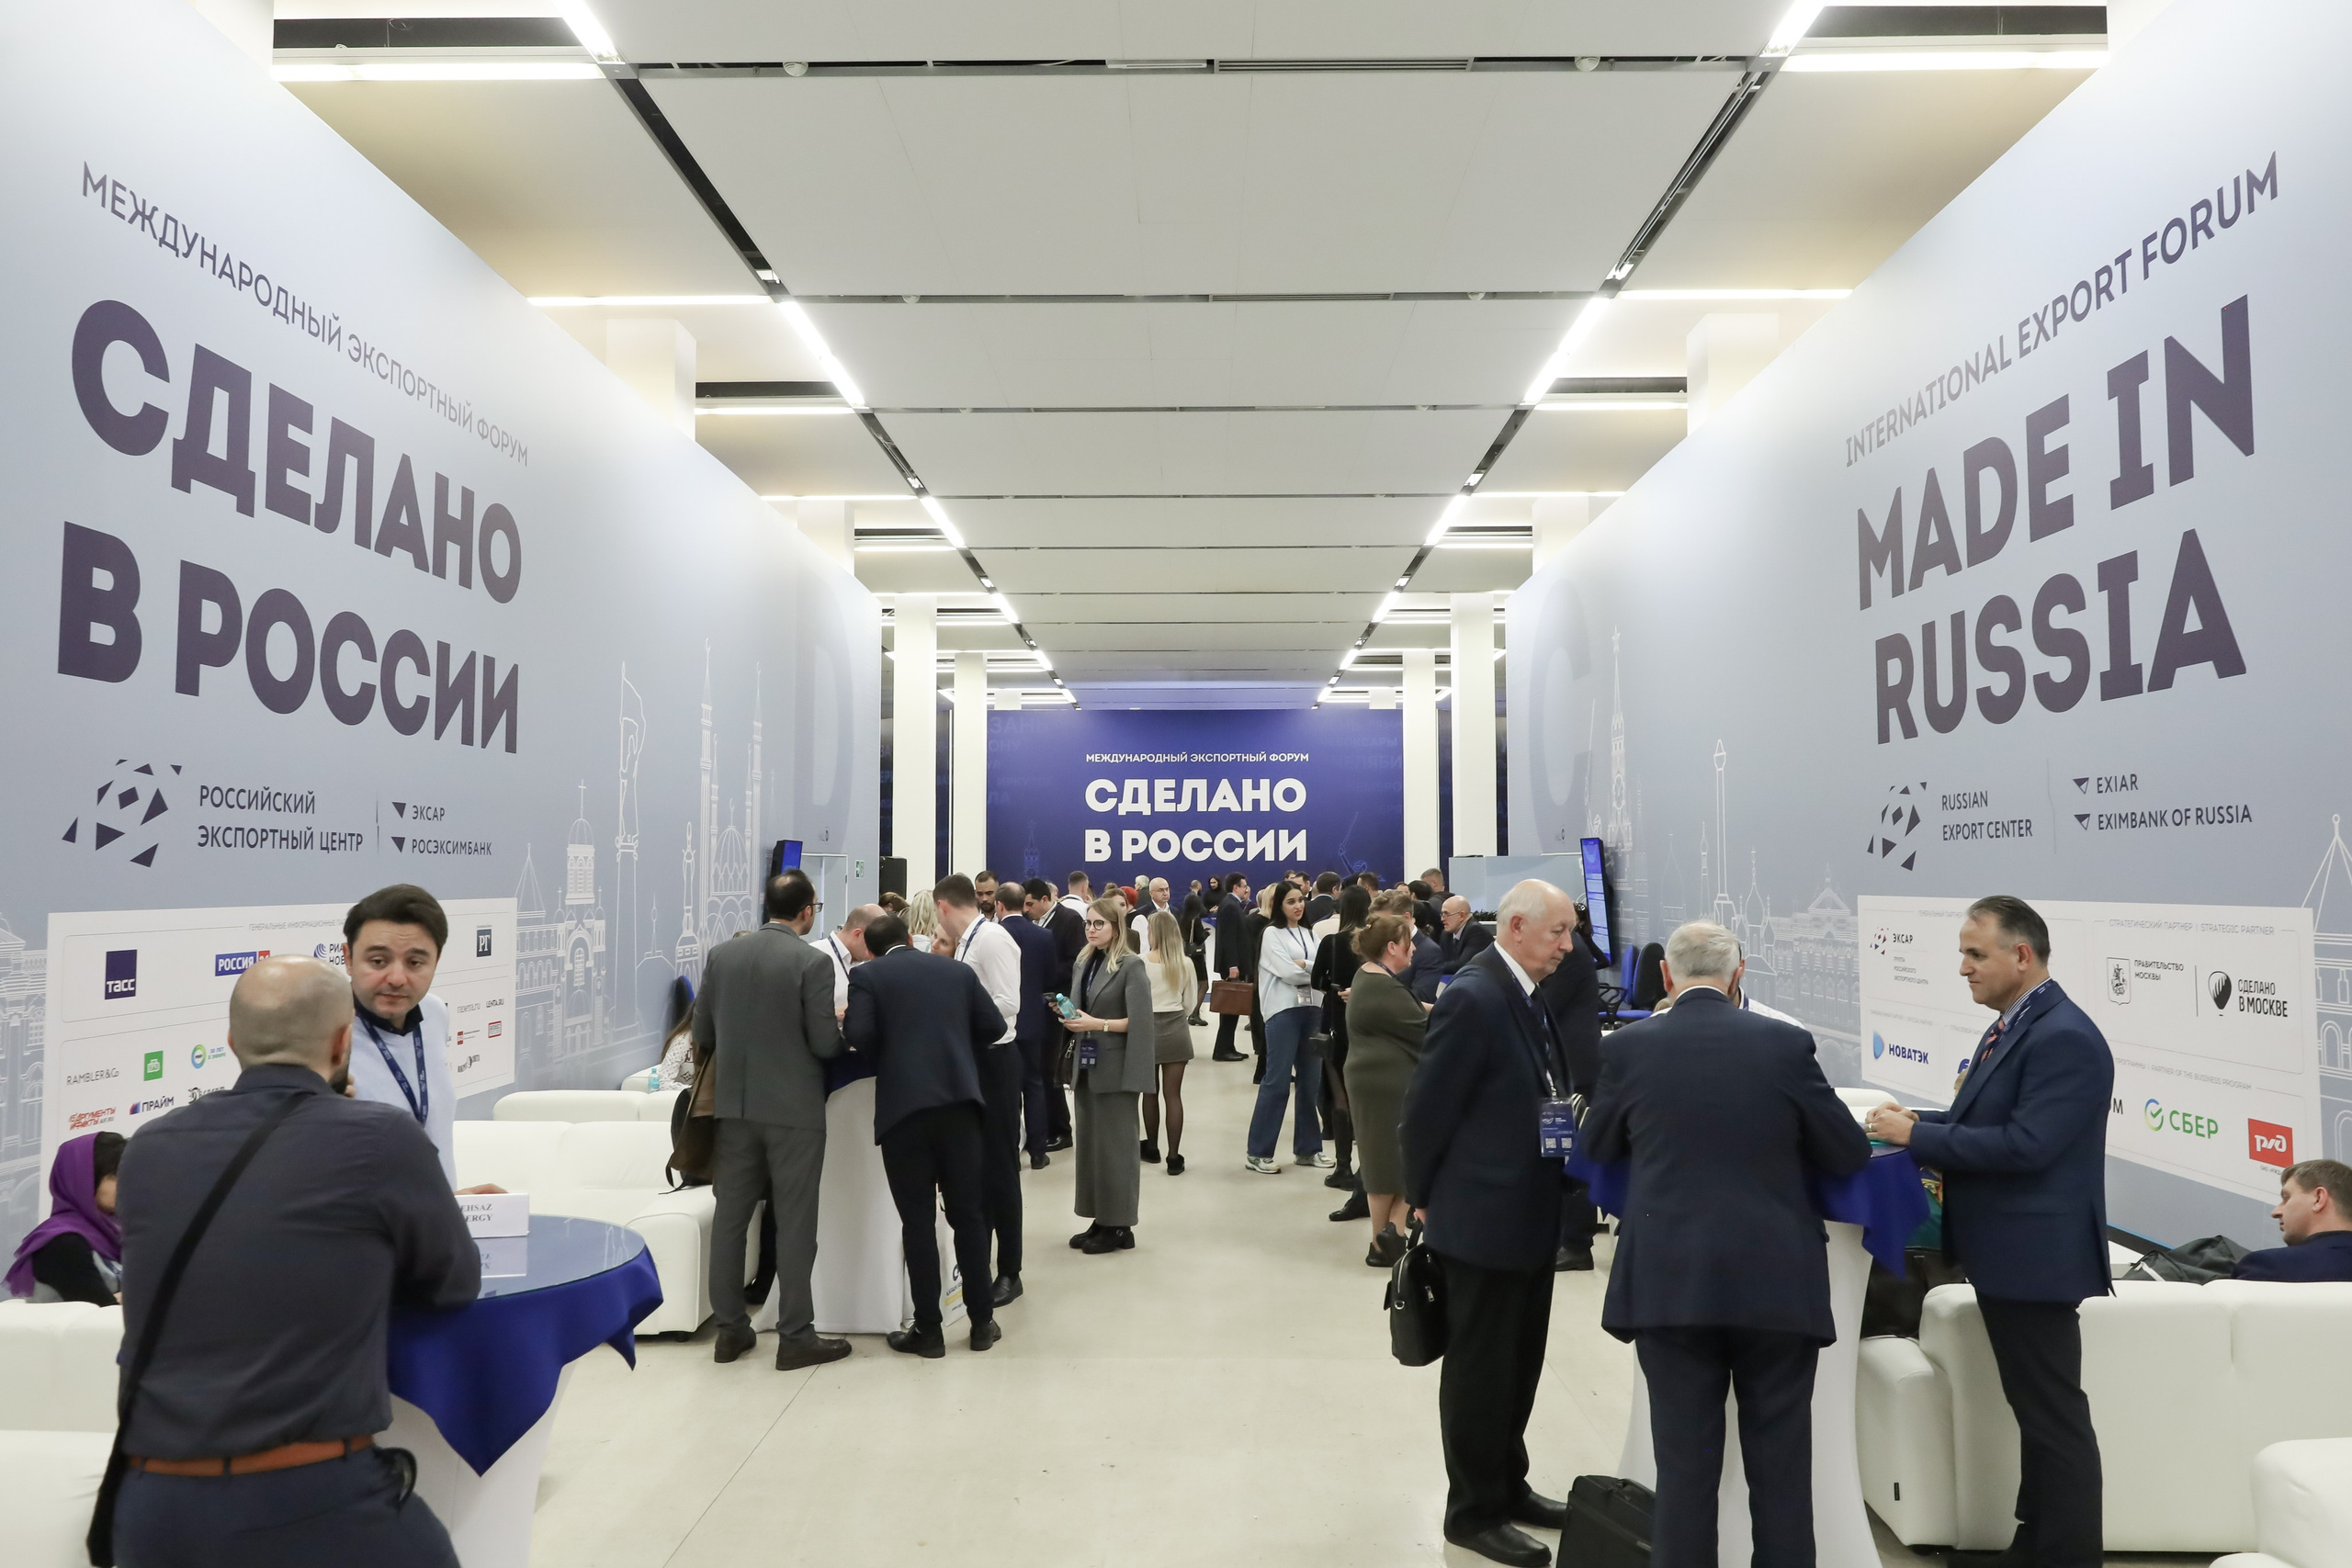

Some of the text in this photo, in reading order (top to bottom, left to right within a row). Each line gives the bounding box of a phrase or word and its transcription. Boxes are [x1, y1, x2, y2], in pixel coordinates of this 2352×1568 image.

[83, 161, 528, 467] МЕЖДУНАРОДНЫЙ ЭКСПОРТНЫЙ ФОРУМ
[1846, 151, 2278, 468] INTERNATIONAL EXPORT FORUM
[71, 299, 522, 604] СДЕЛАНО
[1857, 294, 2255, 611] MADE IN
[57, 520, 518, 754] В РОССИИ
[1874, 528, 2246, 745] RUSSIA
[1085, 750, 1309, 764] МЕЖДУНАРОДНЫЙ ЭКСПОРТНЫЙ ФОРУМ
[2096, 774, 2139, 795] EXIAR
[198, 784, 316, 815] РОССИЙСКИЙ
[1084, 777, 1307, 816] СДЕЛАНО
[1941, 790, 1989, 812] RUSSIAN
[412, 805, 446, 822] ЭКСАР
[2098, 804, 2253, 831] EXIMBANK OF RUSSIA
[197, 824, 364, 854] ЭКСПОРТНЫЙ ЦЕНТР
[1942, 818, 2033, 842] EXPORT CENTER
[412, 839, 492, 856] РОСЭКСИМБАНК
[1084, 829, 1307, 863] В РОССИИ
[2109, 919, 2193, 931] СТРАТЕГИЧЕСКИЙ ПАРТНЕР
[2200, 923, 2275, 936] STRATEGIC PARTNER
[478, 934, 491, 953] РГ
[1893, 932, 1914, 944] ЭКСАР
[218, 956, 254, 972] РОССИЯ
[2134, 960, 2184, 972] ПРАВИТЕЛЬСТВО
[2134, 972, 2161, 981] МОСКВЫ
[2238, 979, 2276, 996] СДЕЛАНО
[2239, 996, 2289, 1018] В МОСКВЕ
[1888, 1043, 1929, 1065] НОВАТЭК
[141, 1096, 175, 1113] ПРАЙМ
[2169, 1110, 2219, 1139] СБЕР
